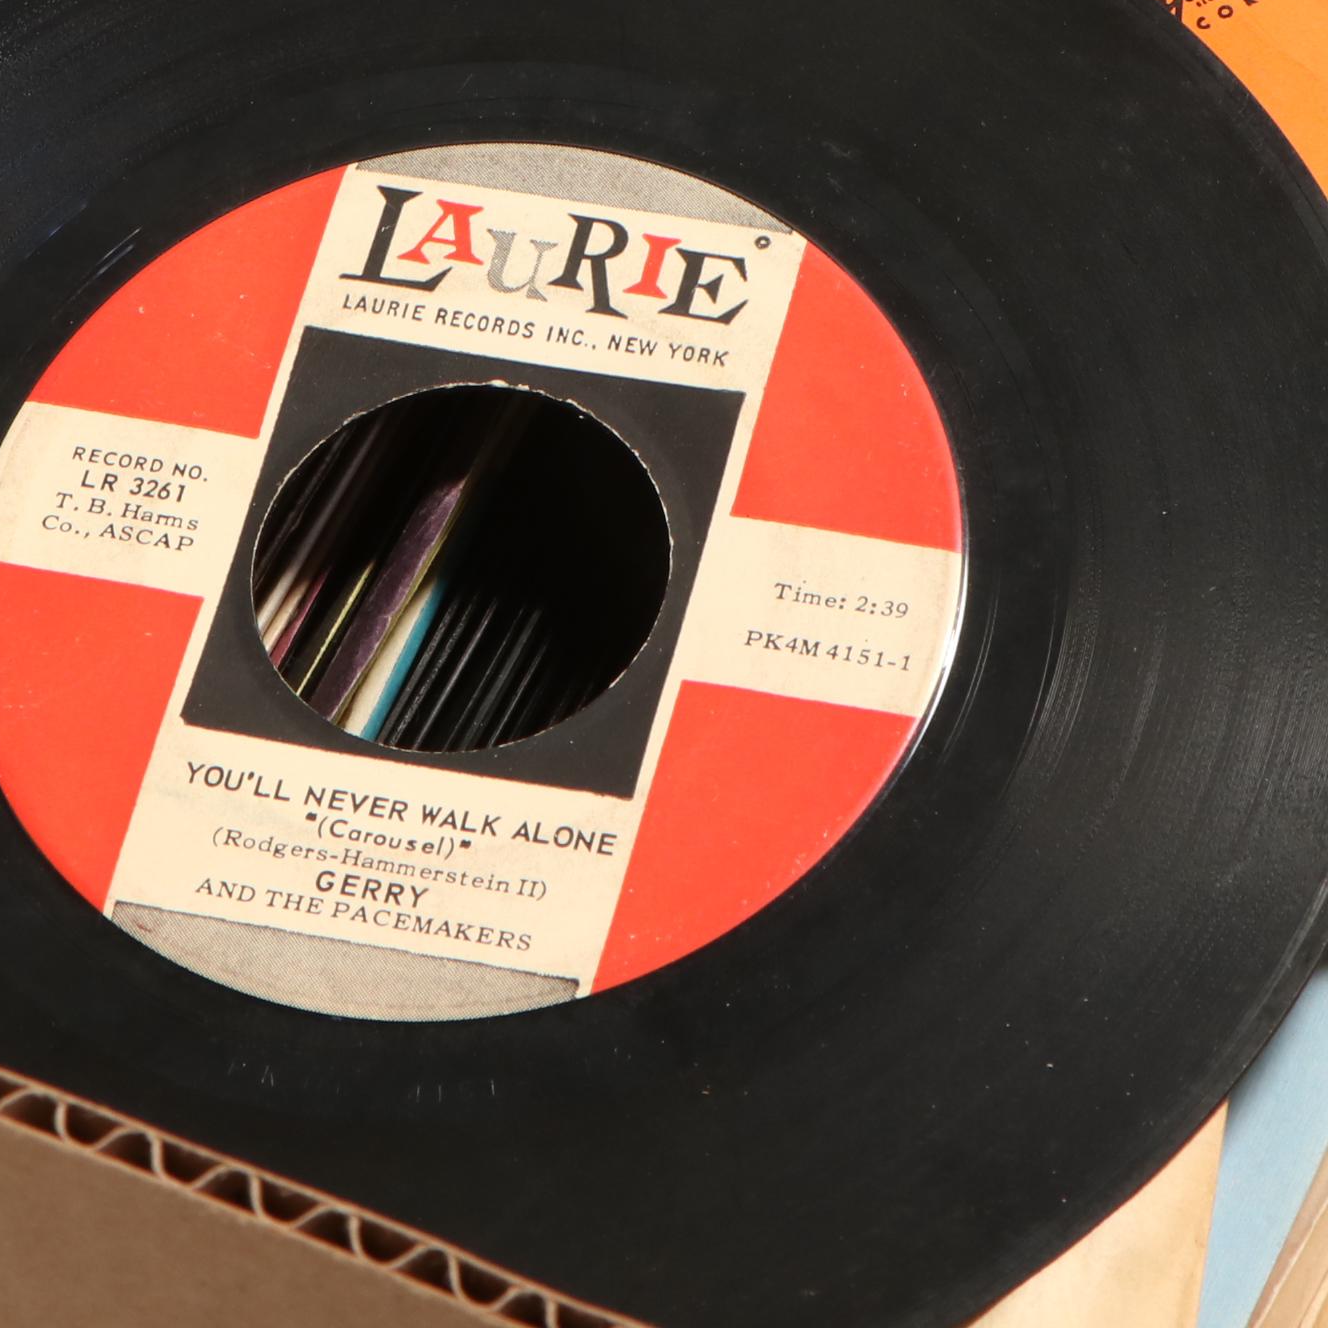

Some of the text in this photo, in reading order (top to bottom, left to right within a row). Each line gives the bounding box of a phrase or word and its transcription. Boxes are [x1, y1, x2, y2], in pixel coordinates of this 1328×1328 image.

[341, 293, 425, 321] LAURIE
[435, 308, 535, 340] RECORDS
[607, 334, 656, 357] NEW
[668, 342, 729, 368] YORK
[72, 446, 208, 482] RECORD NO.
[80, 470, 186, 503] LR 3261
[56, 492, 199, 530] T. B. Harms
[99, 524, 194, 551] ASCAP
[774, 582, 909, 619] Time: 2:39
[186, 761, 619, 857] YOU'LL NEVER WALK ALONE
[211, 826, 511, 894] (Rodgers-Hammerstein
[314, 870, 430, 909] GERRY
[195, 877, 533, 952] AND THE PACEMAKERS
